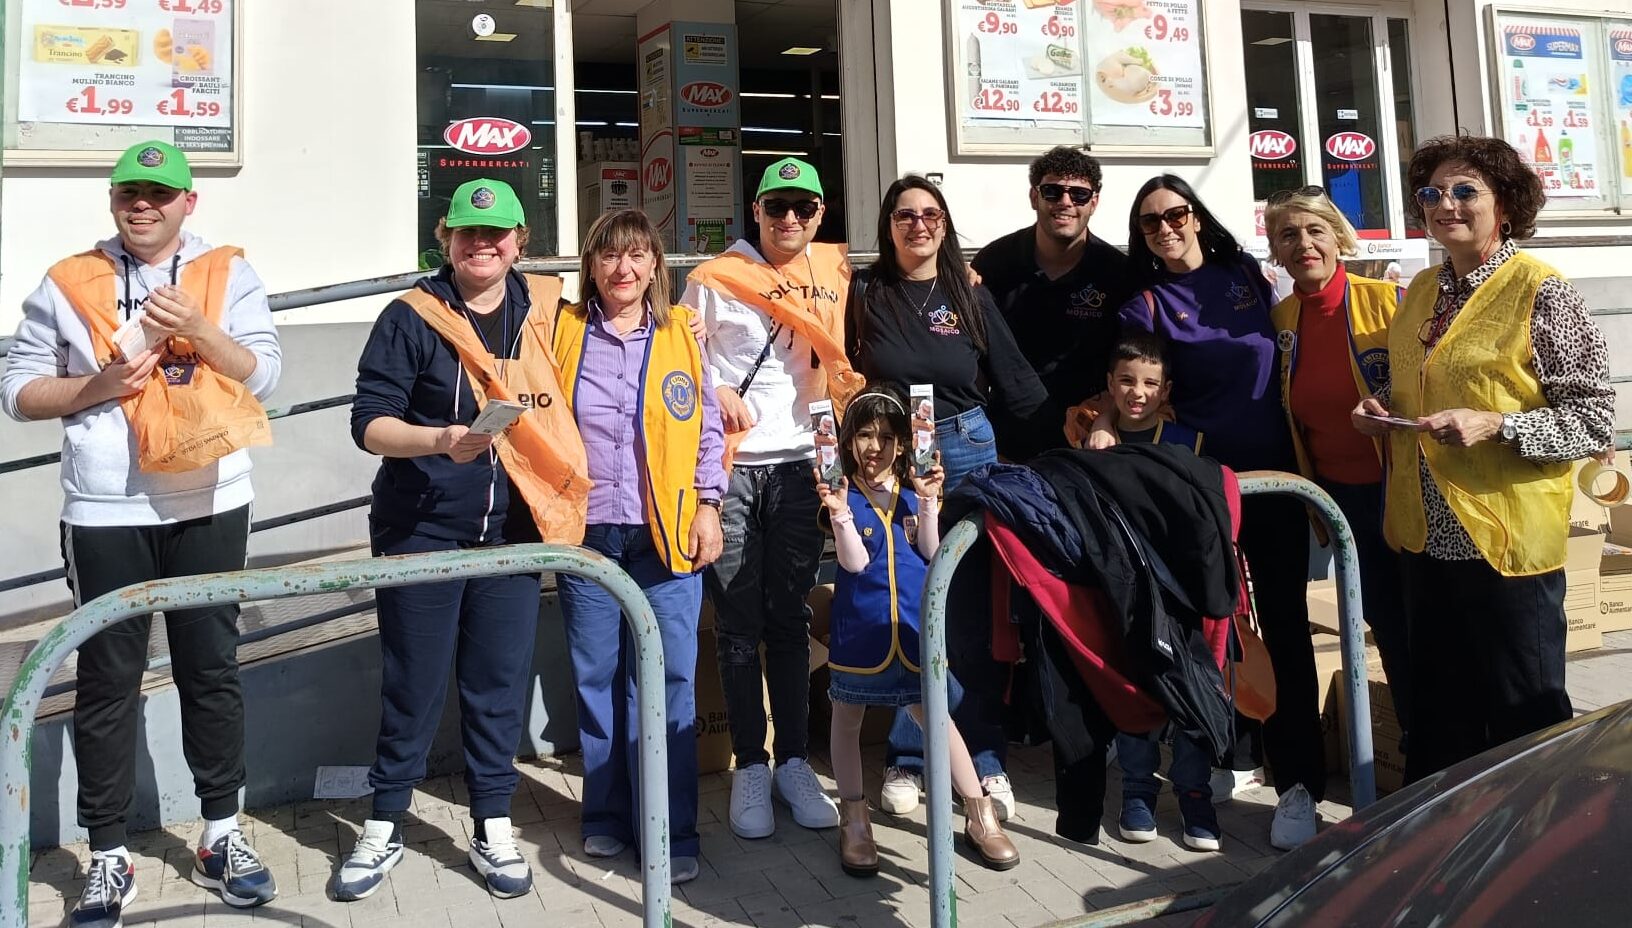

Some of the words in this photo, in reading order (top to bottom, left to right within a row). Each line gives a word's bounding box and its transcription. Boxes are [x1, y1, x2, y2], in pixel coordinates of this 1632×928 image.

[977, 12, 1017, 35] €9,90
[1041, 15, 1074, 38] €6,90
[1144, 14, 1189, 42] €9,49
[66, 86, 133, 114] €1,99
[156, 89, 220, 118] €1,59
[688, 85, 728, 103] MAX
[974, 89, 1020, 111] €12,90
[1033, 92, 1078, 114] €12,90
[1150, 90, 1193, 118] €3,99
[456, 122, 526, 149] MAX
[1251, 134, 1290, 155] MAX
[1333, 136, 1371, 156] MAX
[440, 158, 530, 168] SUPERMERCATI
[1253, 162, 1298, 170] PERMERCATI
[648, 160, 670, 189] MAX
[929, 326, 960, 335] MOSAICO
